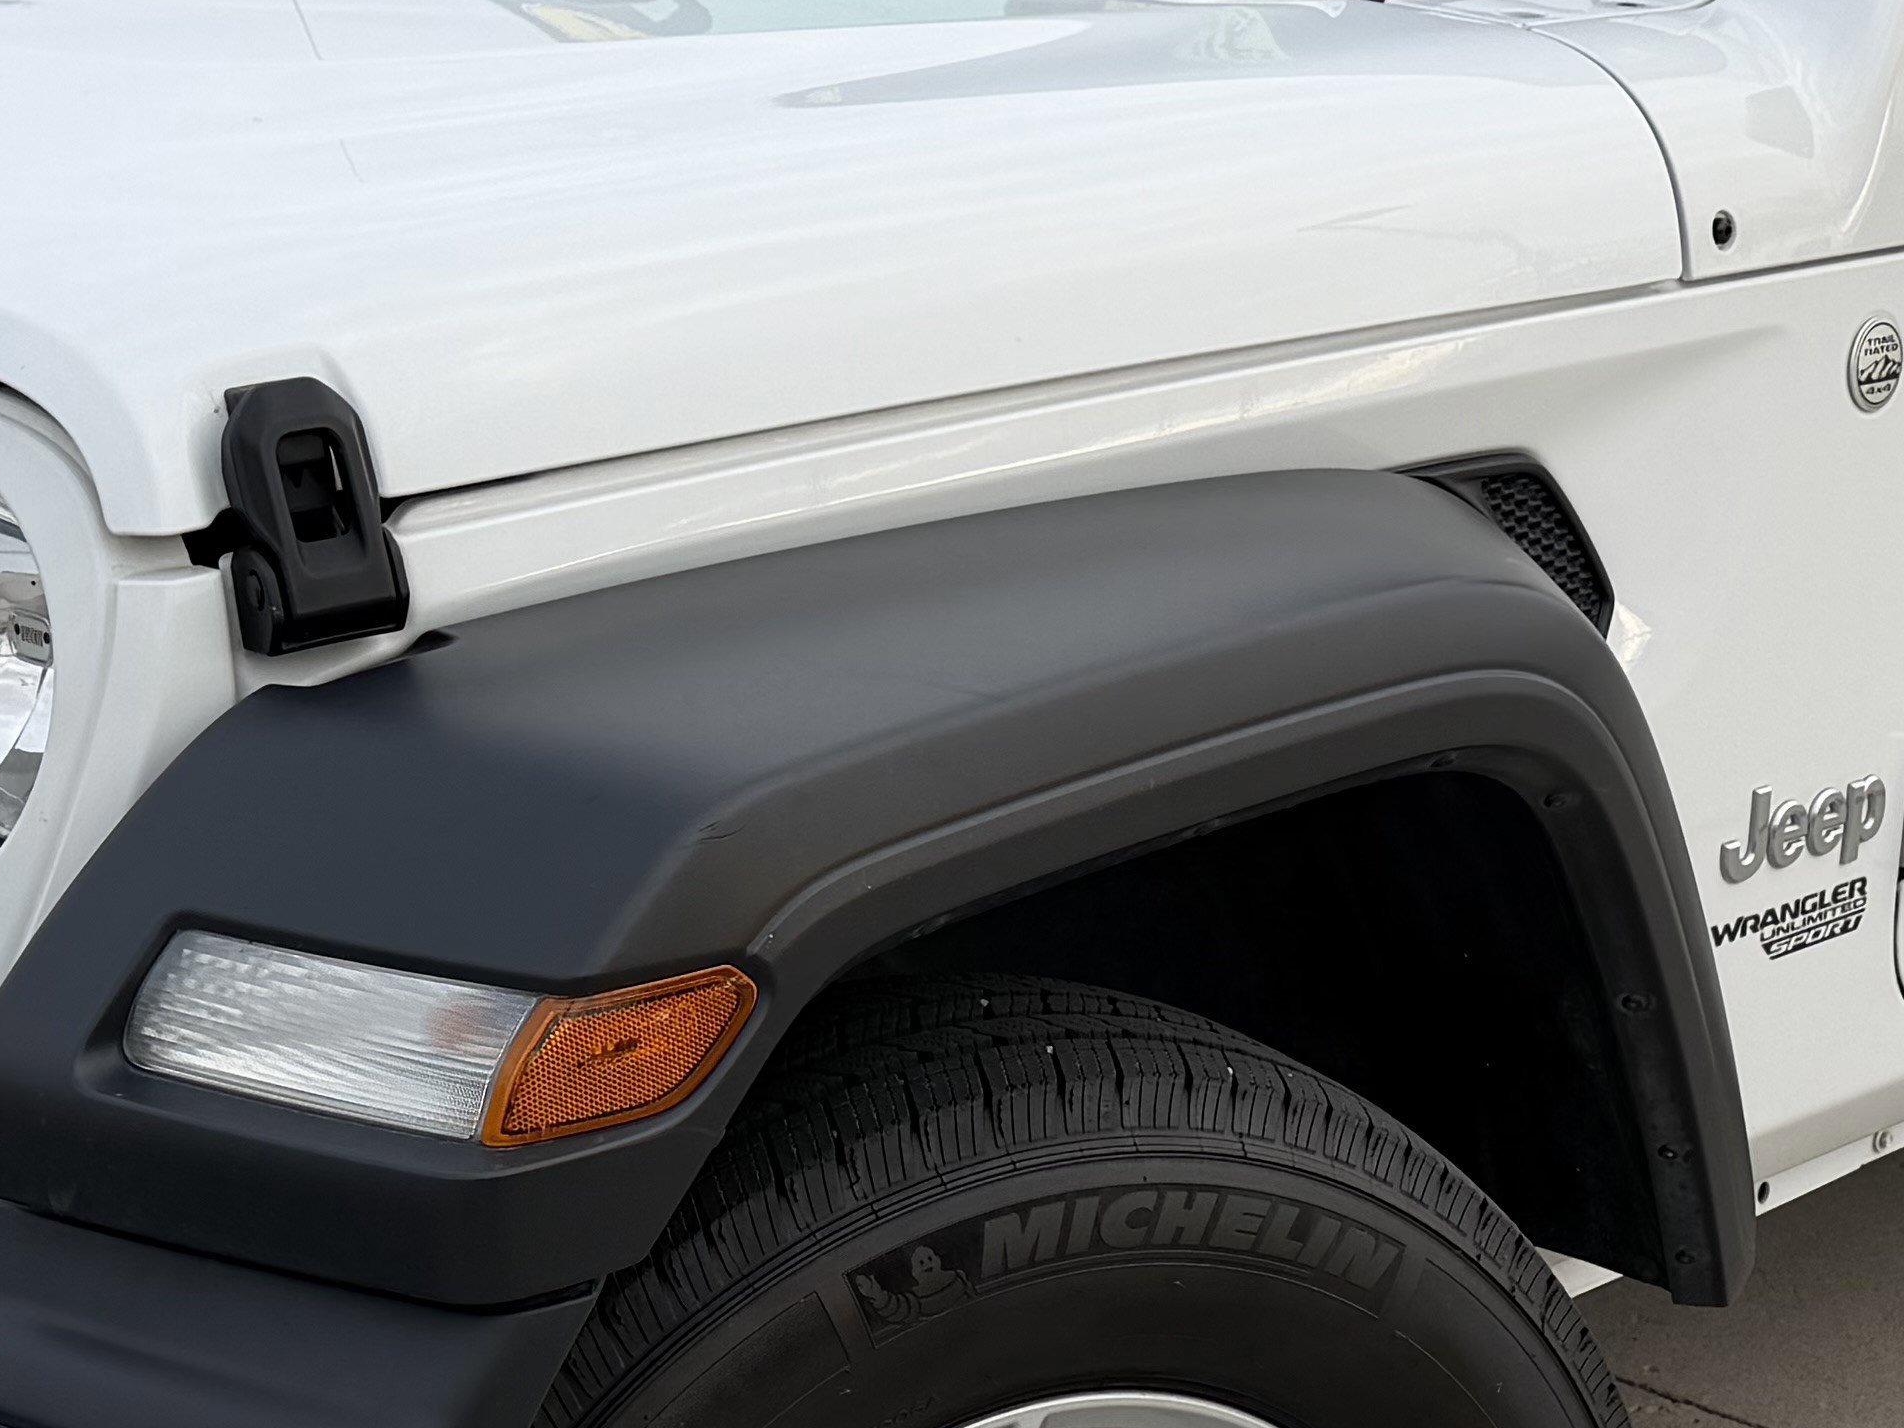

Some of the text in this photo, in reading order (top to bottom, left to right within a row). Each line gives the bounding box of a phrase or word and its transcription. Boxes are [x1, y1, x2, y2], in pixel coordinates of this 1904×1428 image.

[1864, 343, 1899, 356] RATED
[1867, 334, 1896, 346] TRAIL
[1719, 773, 1888, 884] Jeep
[1710, 876, 1868, 947] WRANGLER
[1759, 896, 1867, 943] UNLIMITED
[1766, 913, 1864, 958] SPORT
[980, 1189, 1404, 1293] MICHELIN
